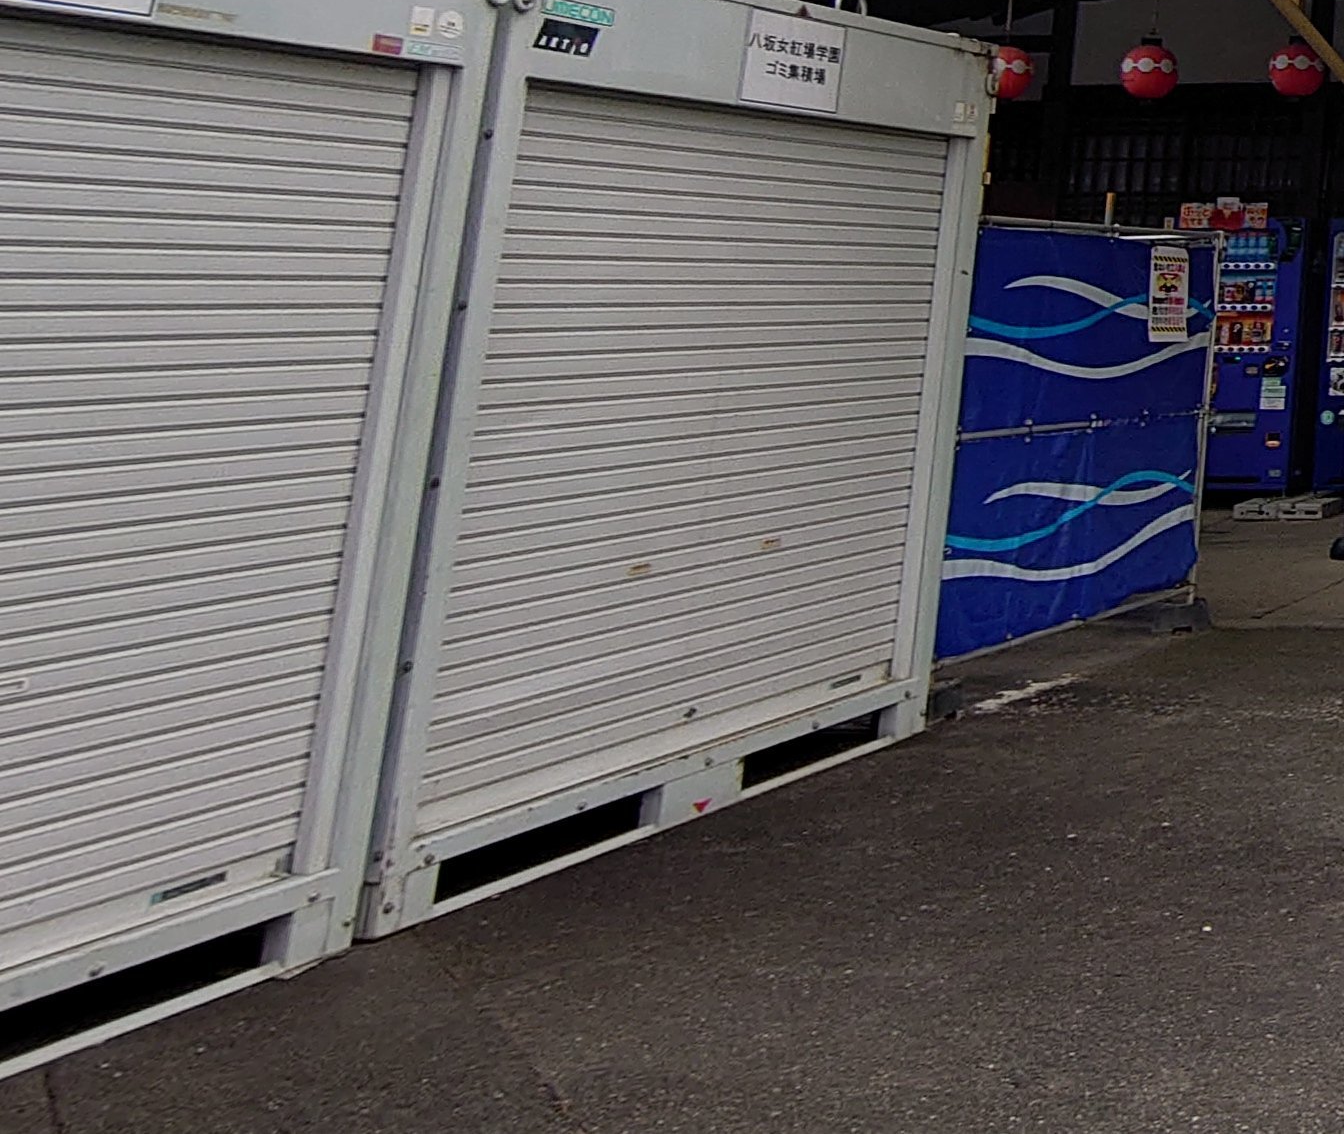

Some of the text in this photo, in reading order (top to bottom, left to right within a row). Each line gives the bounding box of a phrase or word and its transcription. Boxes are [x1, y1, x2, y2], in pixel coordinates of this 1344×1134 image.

[765, 60, 826, 85] ゴミ集積場
